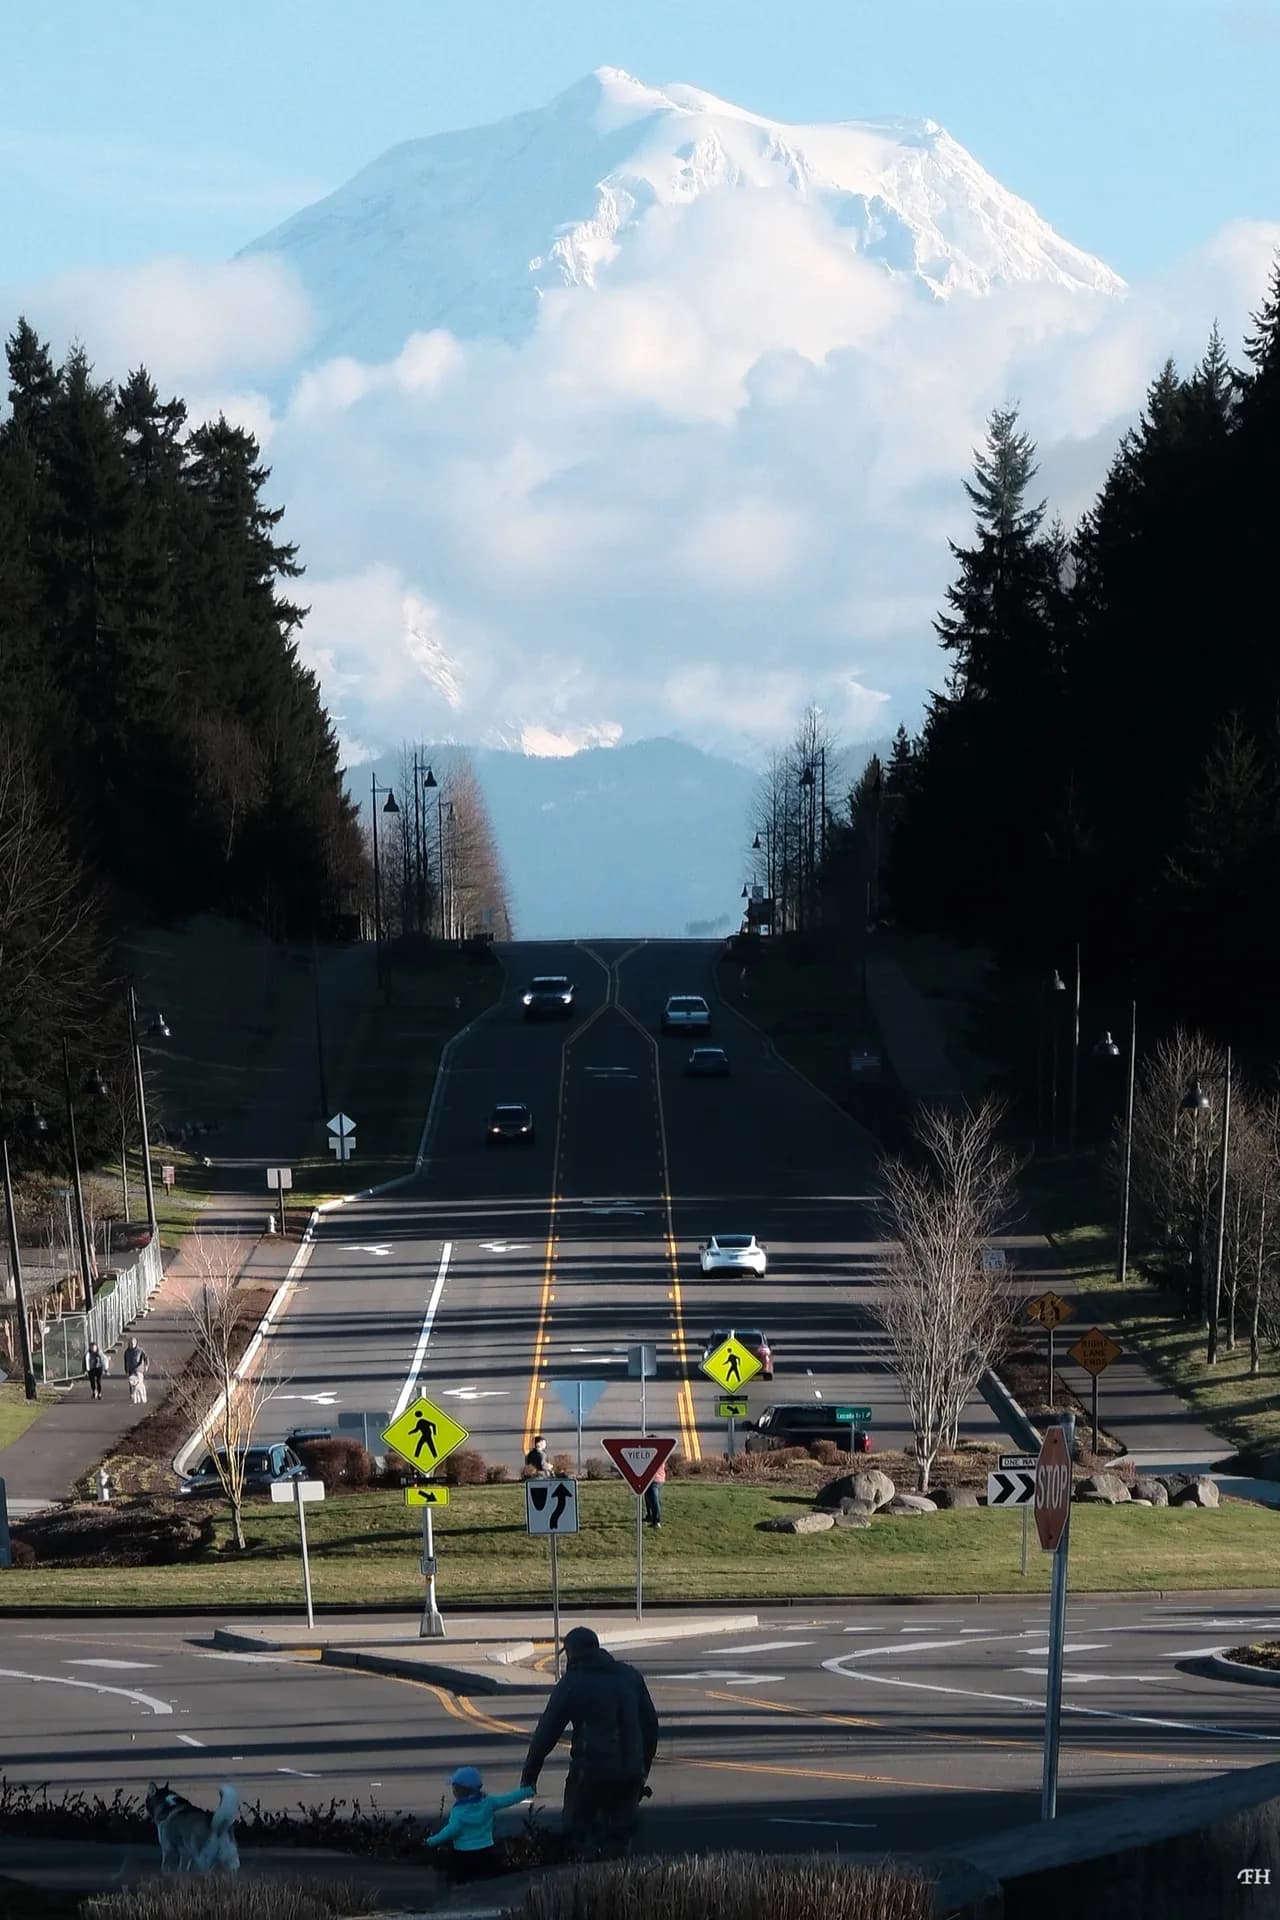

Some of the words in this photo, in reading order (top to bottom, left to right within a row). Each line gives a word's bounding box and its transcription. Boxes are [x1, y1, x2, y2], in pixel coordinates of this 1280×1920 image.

[1082, 1339, 1107, 1348] RIGHT
[1083, 1349, 1104, 1357] LANE
[1083, 1358, 1107, 1366] ENDS
[628, 1451, 650, 1459] YIELD
[1037, 1465, 1068, 1510] STOP
